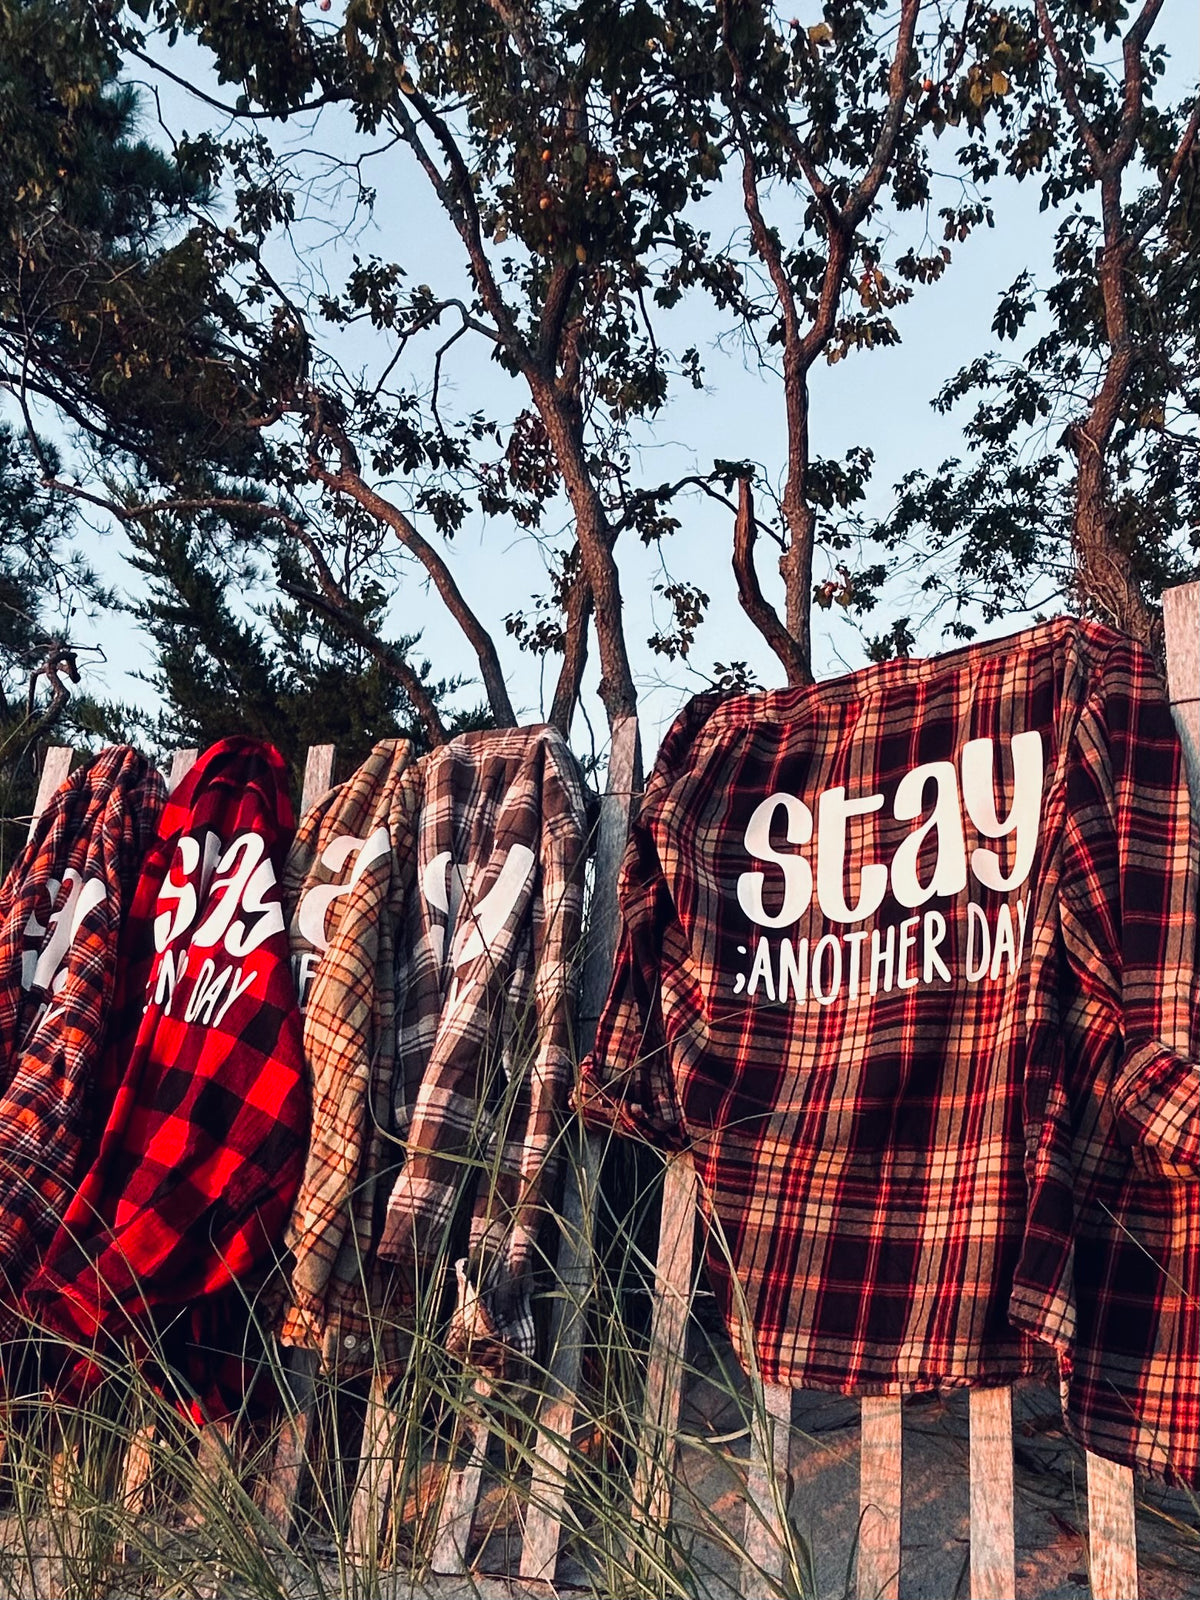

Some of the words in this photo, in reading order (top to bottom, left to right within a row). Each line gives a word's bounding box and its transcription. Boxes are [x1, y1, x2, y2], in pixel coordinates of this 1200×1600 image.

[737, 731, 1043, 928] stay
[966, 890, 1031, 982] DAY
[184, 958, 257, 1028] DAY
